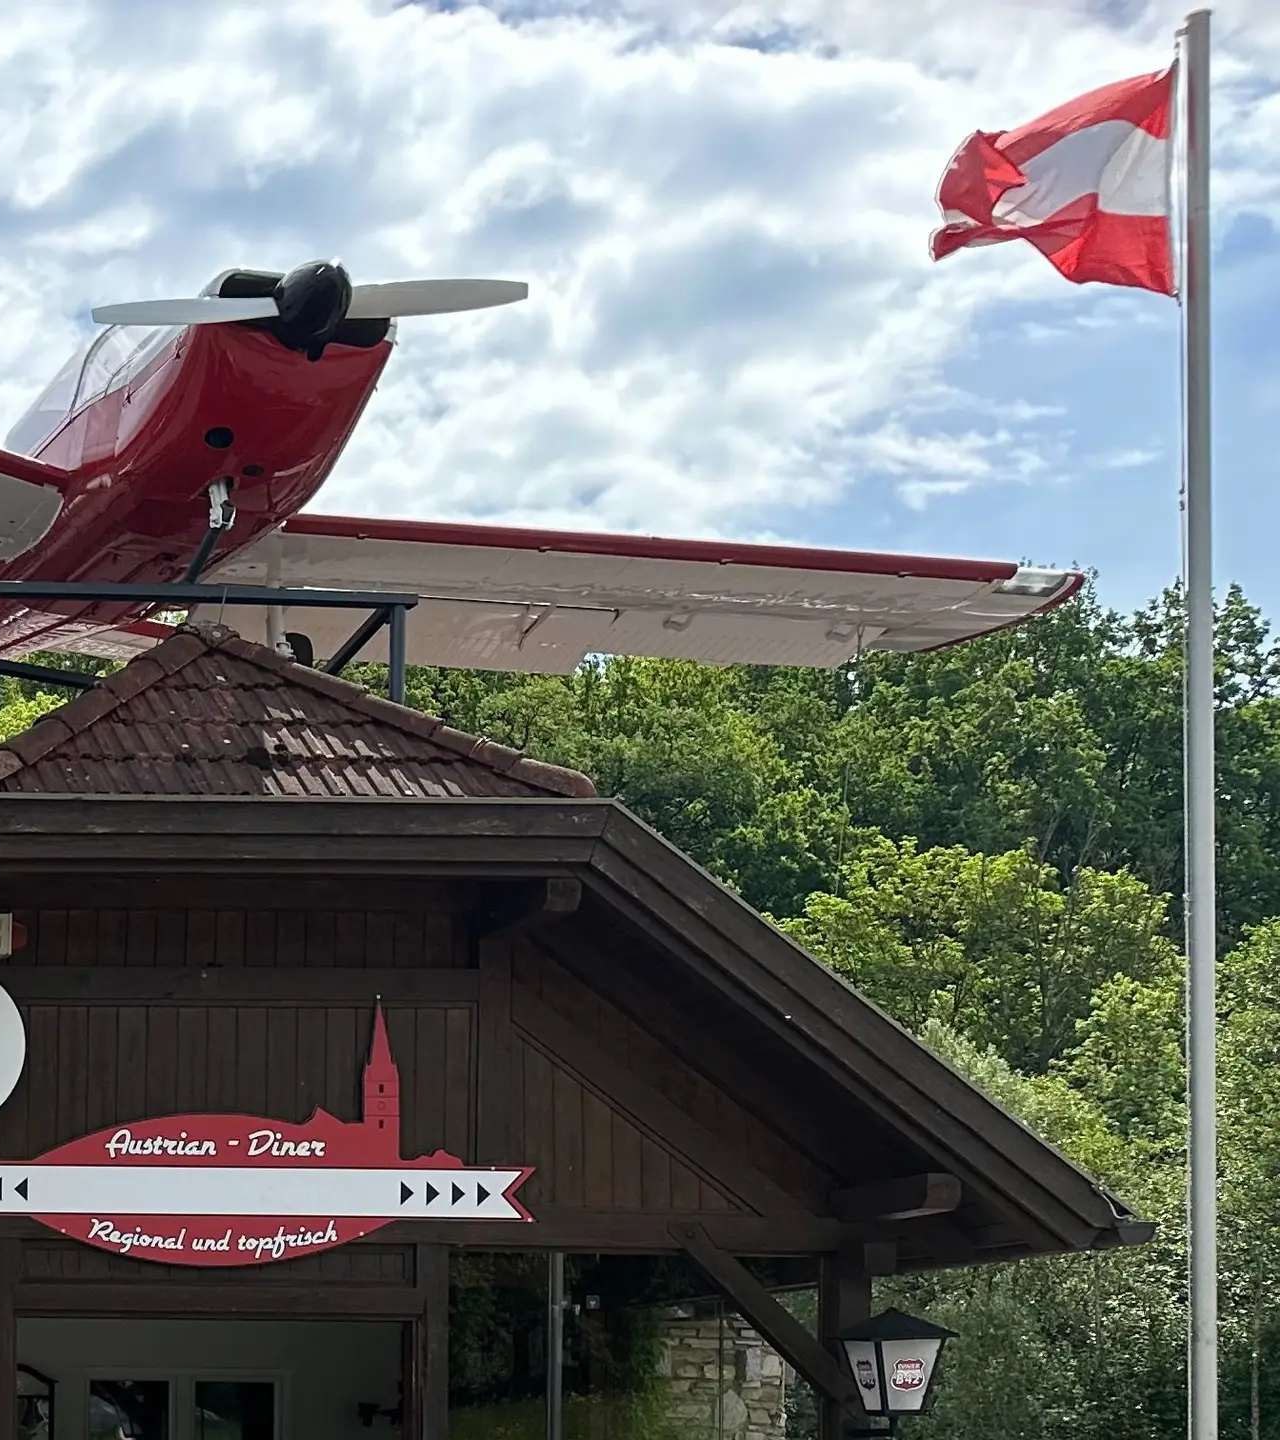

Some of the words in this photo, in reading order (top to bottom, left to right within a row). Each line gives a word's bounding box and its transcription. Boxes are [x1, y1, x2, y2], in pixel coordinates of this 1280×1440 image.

[105, 1129, 217, 1158] Austrian
[247, 1129, 327, 1157] Diner
[87, 1218, 187, 1254] Regional
[192, 1229, 232, 1251] und
[237, 1220, 338, 1259] topfrisch
